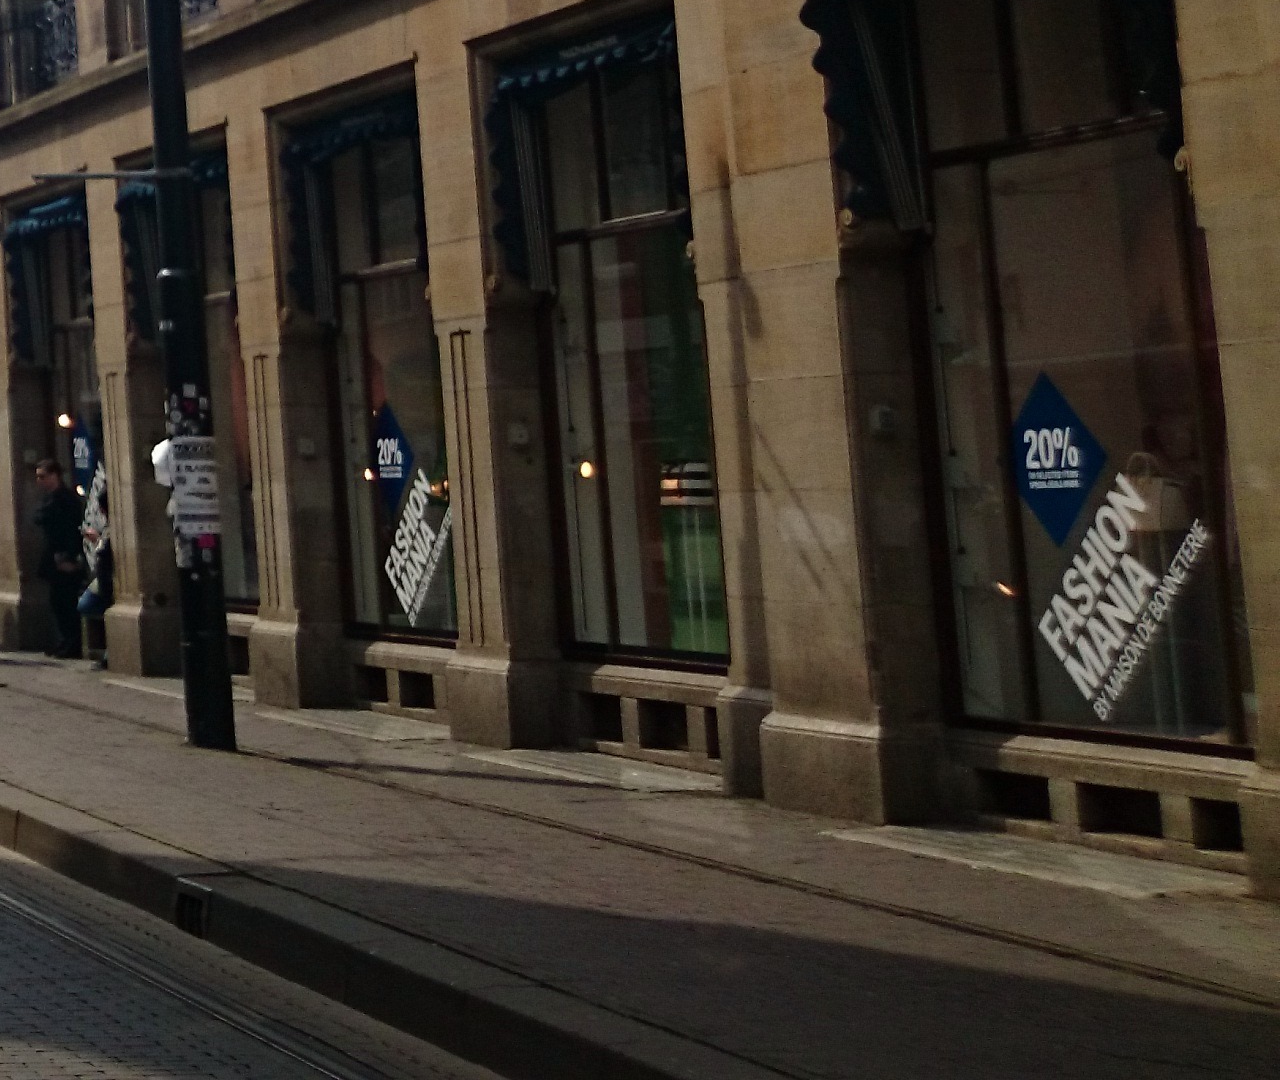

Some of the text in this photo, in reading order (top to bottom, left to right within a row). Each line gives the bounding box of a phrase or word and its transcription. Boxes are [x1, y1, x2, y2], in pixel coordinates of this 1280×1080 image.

[377, 438, 403, 465] 20%
[1024, 426, 1079, 469] 20%
[385, 468, 431, 589] FASHION
[397, 520, 436, 614] MANIA
[1038, 472, 1146, 662] FASHION
[1064, 554, 1158, 700] MANIA
[1093, 692, 1113, 721] BY
[1136, 611, 1157, 642] DE
